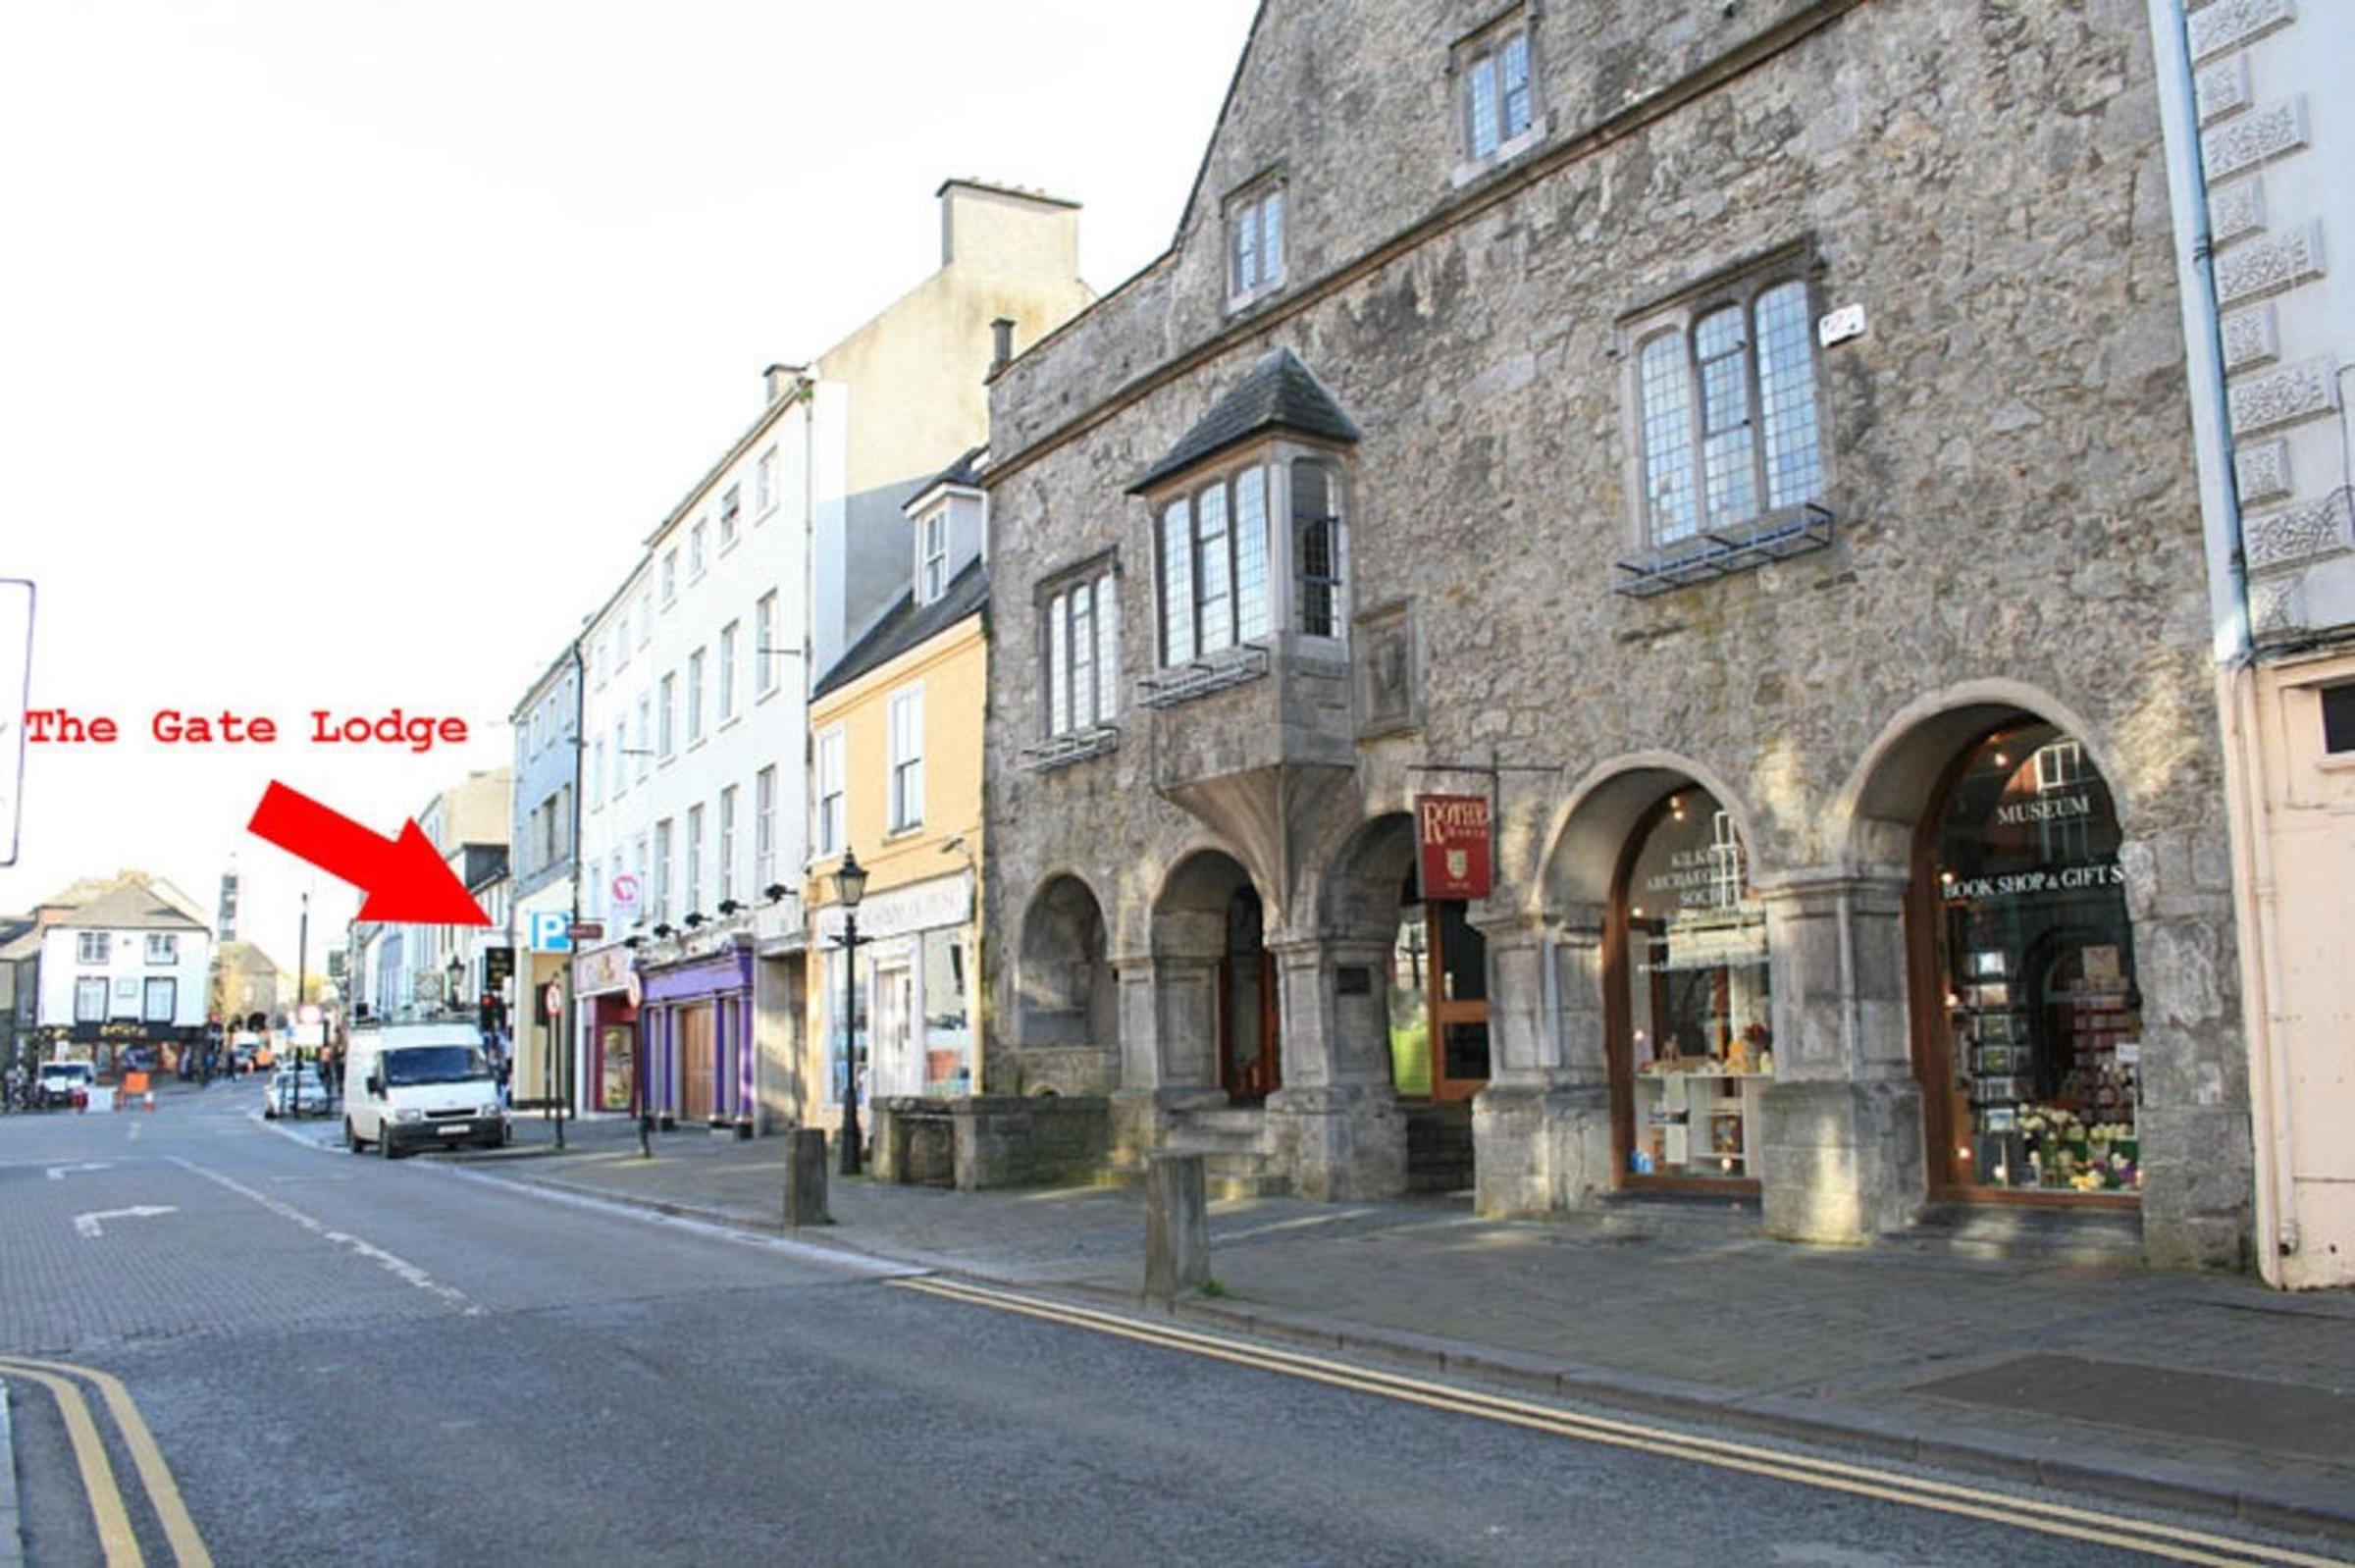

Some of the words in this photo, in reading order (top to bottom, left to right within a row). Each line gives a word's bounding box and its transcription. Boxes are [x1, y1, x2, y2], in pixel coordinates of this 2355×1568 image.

[1997, 795, 2091, 825] MUSEUM
[1997, 872, 2045, 895] SHOP
[2061, 864, 2124, 888] GIFTS
[538, 914, 566, 949] P
